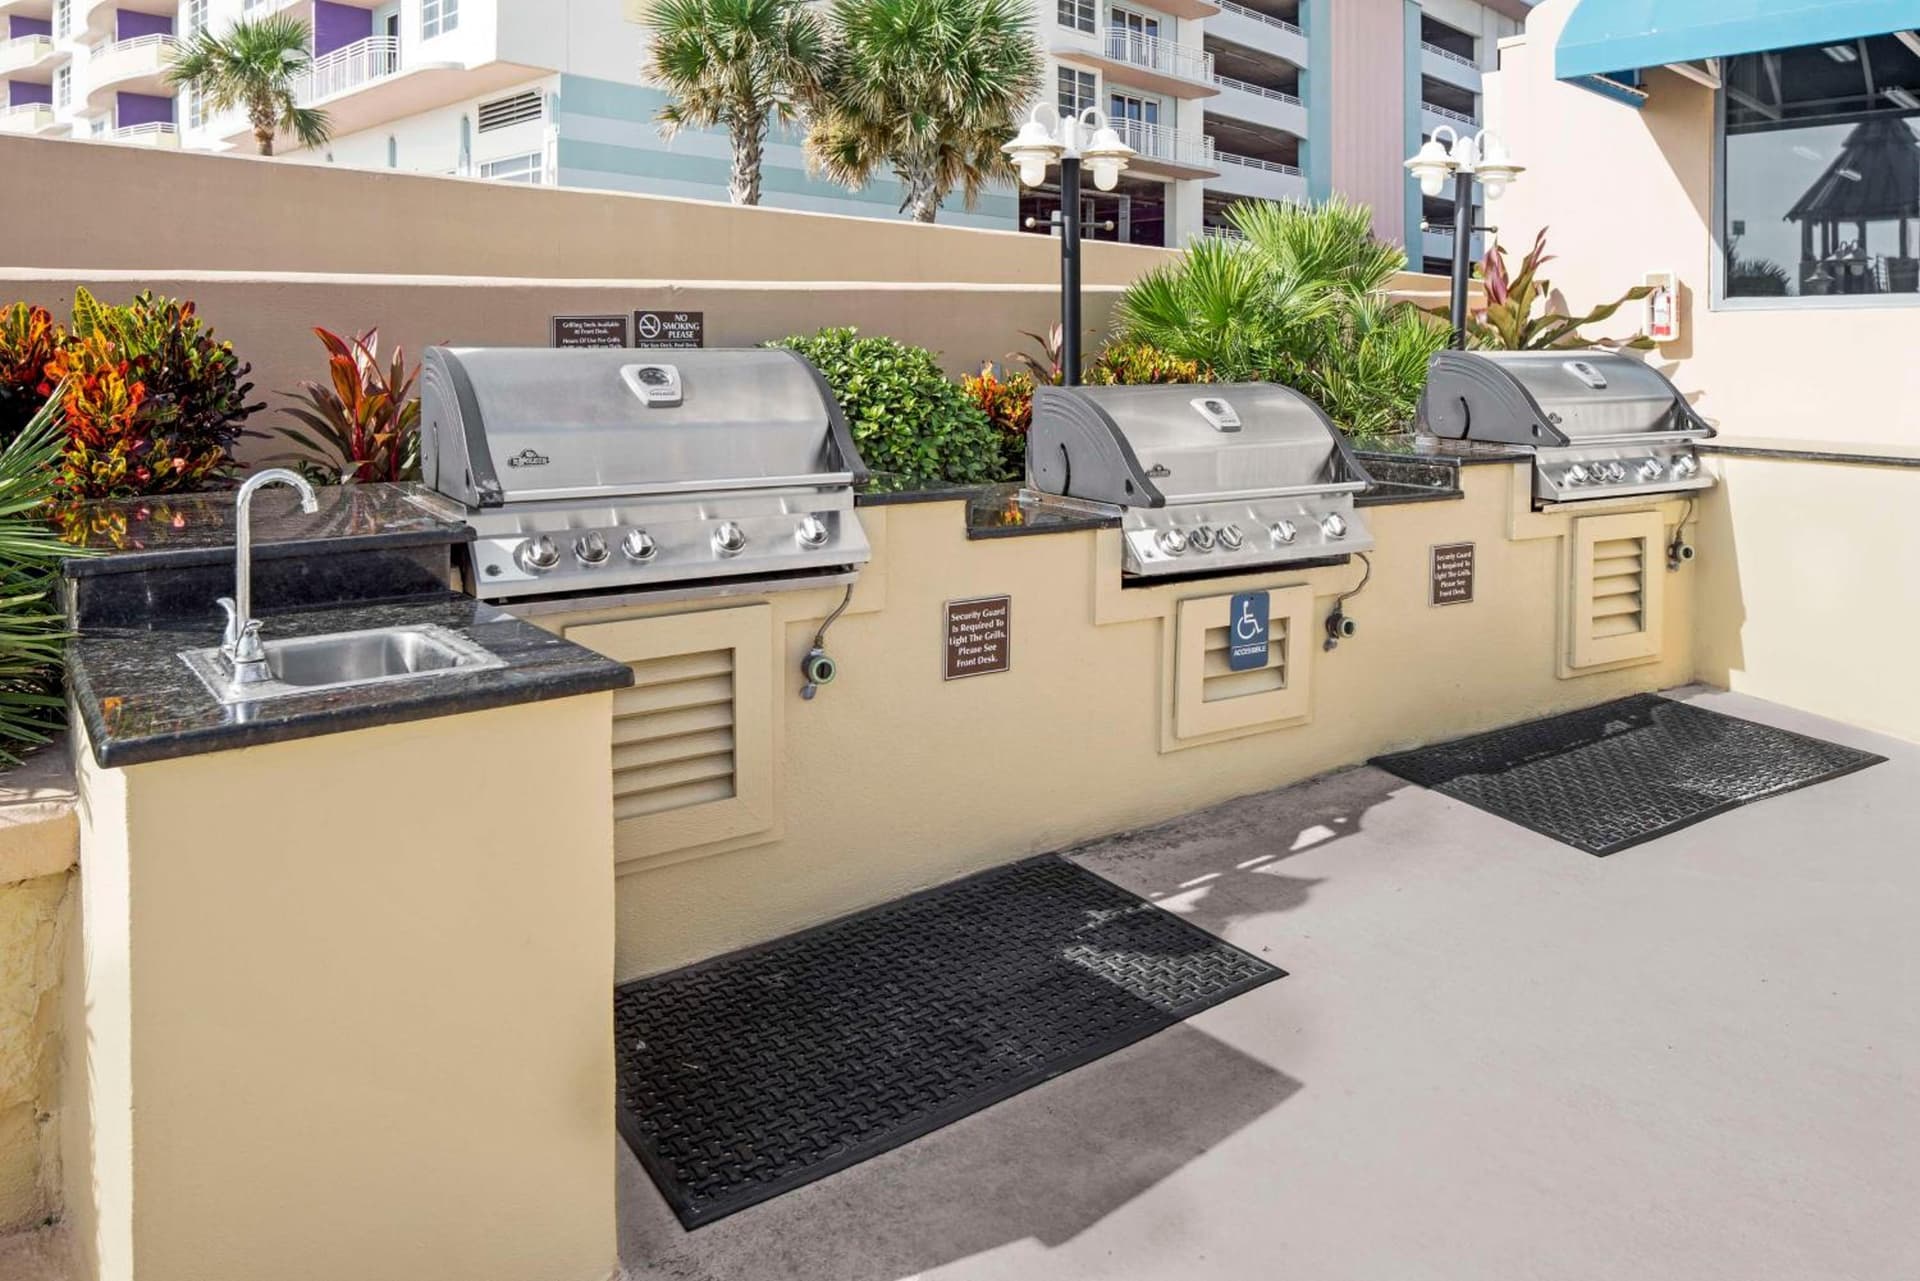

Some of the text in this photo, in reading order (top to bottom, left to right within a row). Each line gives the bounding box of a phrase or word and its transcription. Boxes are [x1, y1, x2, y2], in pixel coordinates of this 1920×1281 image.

[675, 314, 688, 322] NO
[662, 321, 700, 330] SMOKING
[668, 331, 694, 339] PLEASE
[951, 606, 1006, 621] Security Guard
[952, 619, 1004, 633] Is Required To
[949, 635, 968, 647] Light
[969, 633, 983, 642] The
[958, 643, 997, 656] Please See
[956, 654, 999, 668] Front Desk.
